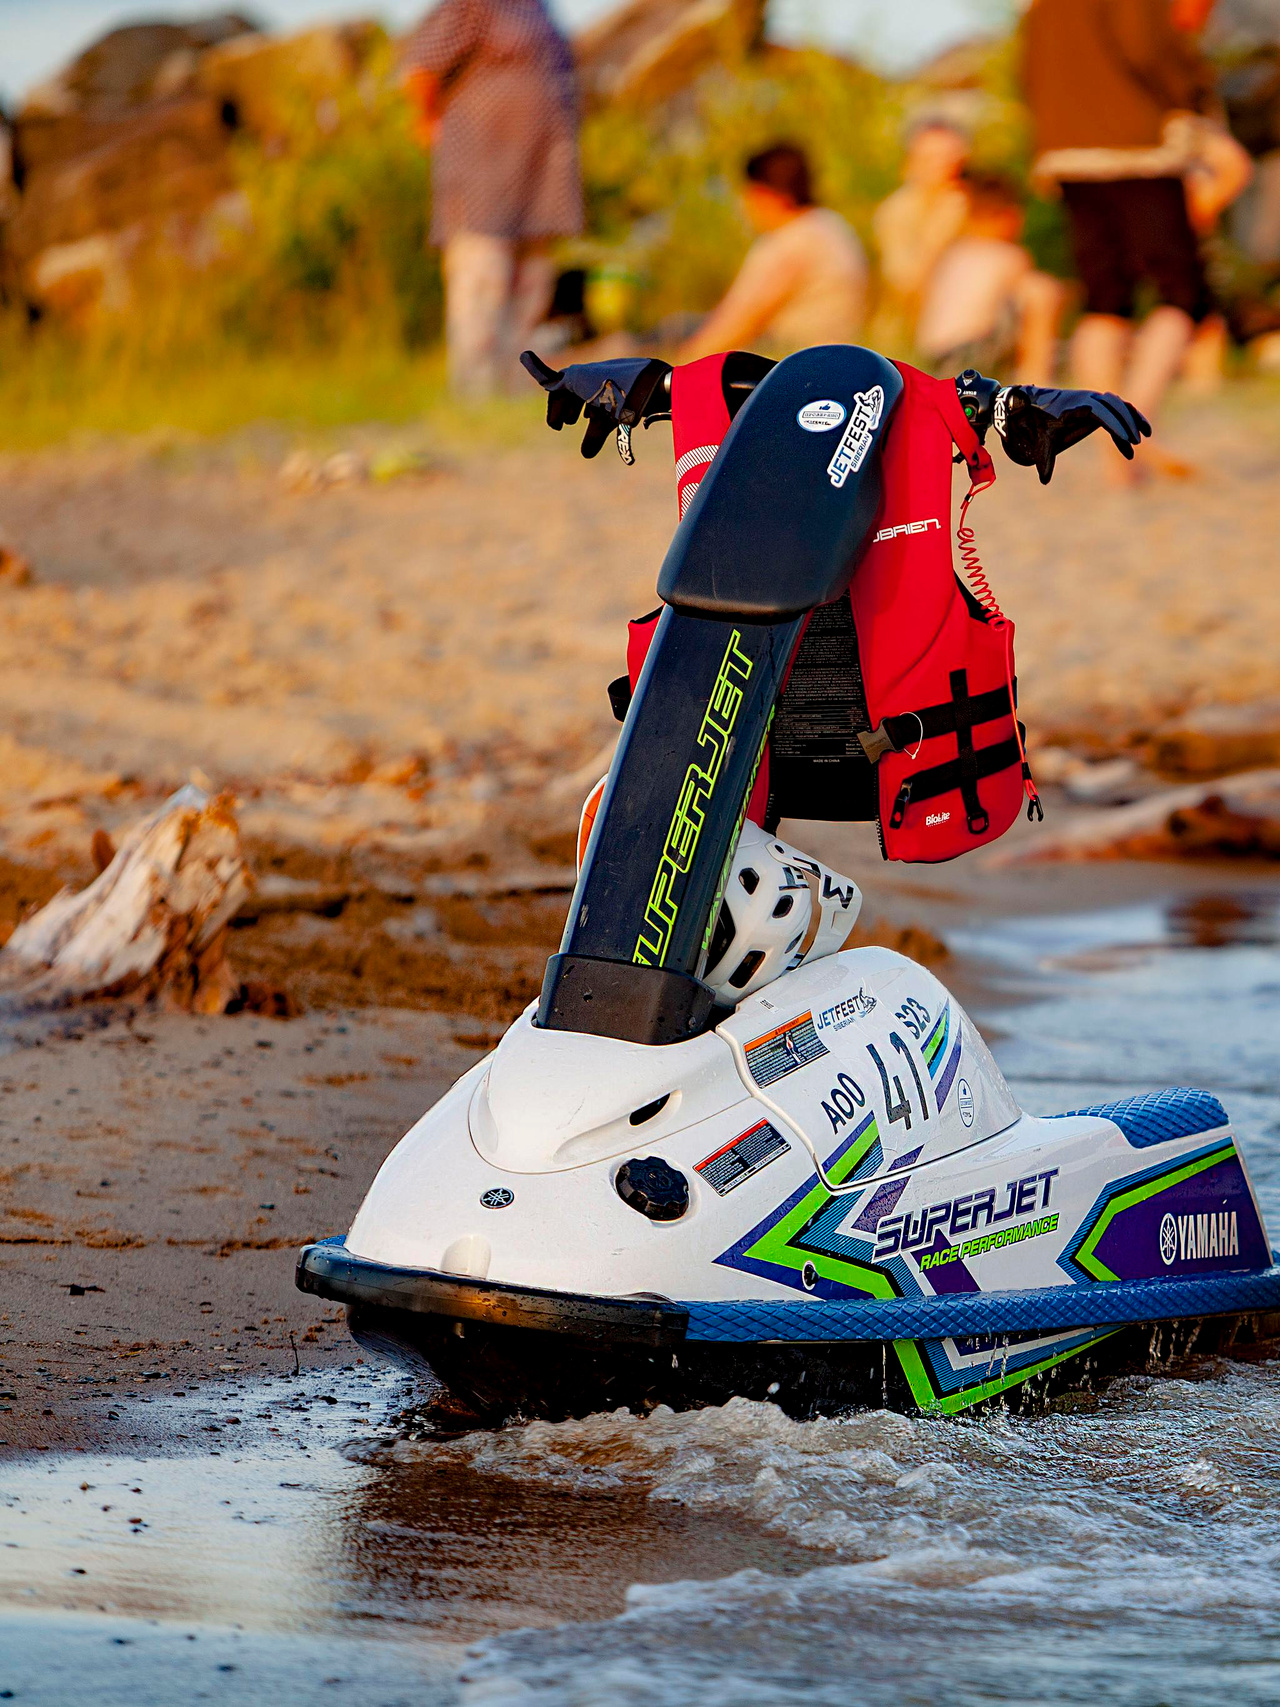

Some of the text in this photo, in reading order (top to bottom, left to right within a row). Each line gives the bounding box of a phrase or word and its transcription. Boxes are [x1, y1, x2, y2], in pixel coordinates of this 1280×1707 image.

[830, 405, 871, 484] JETFEST
[850, 433, 870, 469] SIBERIAN
[817, 994, 860, 1031] JETFEST
[865, 1031, 930, 1131] 41
[873, 1167, 1060, 1260] SUPERJET
[919, 1213, 1060, 1272] RACE PERFORMANCE
[1177, 1211, 1239, 1260] YAMAHA
